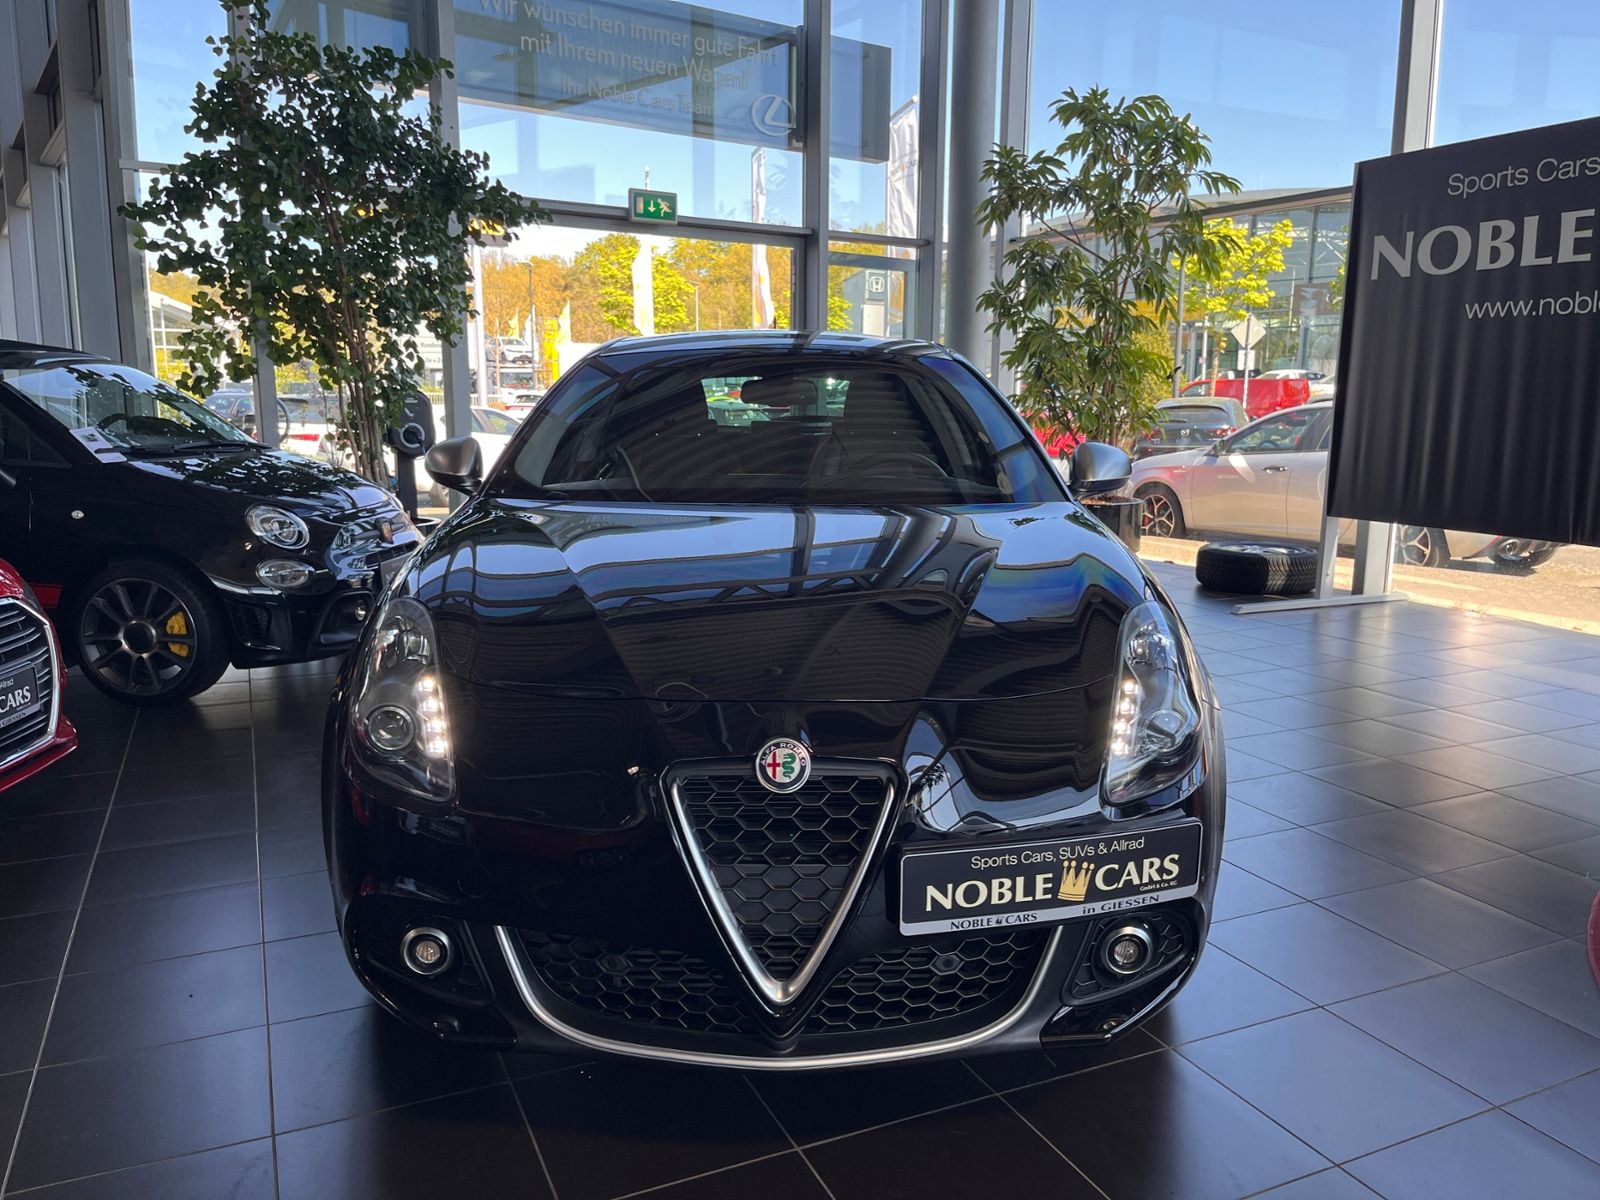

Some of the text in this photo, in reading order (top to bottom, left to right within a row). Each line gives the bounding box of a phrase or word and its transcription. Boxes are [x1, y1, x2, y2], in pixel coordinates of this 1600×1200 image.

[523, 1, 626, 35] wünschen
[630, 16, 690, 48] immer
[694, 35, 733, 57] gute
[520, 33, 552, 54] mit
[558, 31, 616, 65] Ihrem
[621, 53, 678, 77] neuen
[586, 78, 635, 105] Noble
[1447, 165, 1529, 199] Sports
[1370, 208, 1596, 281] NOBLE
[0, 686, 31, 713] CARS
[760, 742, 806, 767] ALFA ROMEO
[970, 836, 1145, 870] Sports Cars, SUVs & Allrad
[925, 853, 1180, 912] NOBLE CARS
[950, 912, 1038, 930] NOBLE CARS
[1082, 894, 1160, 915] in GIESSEN
